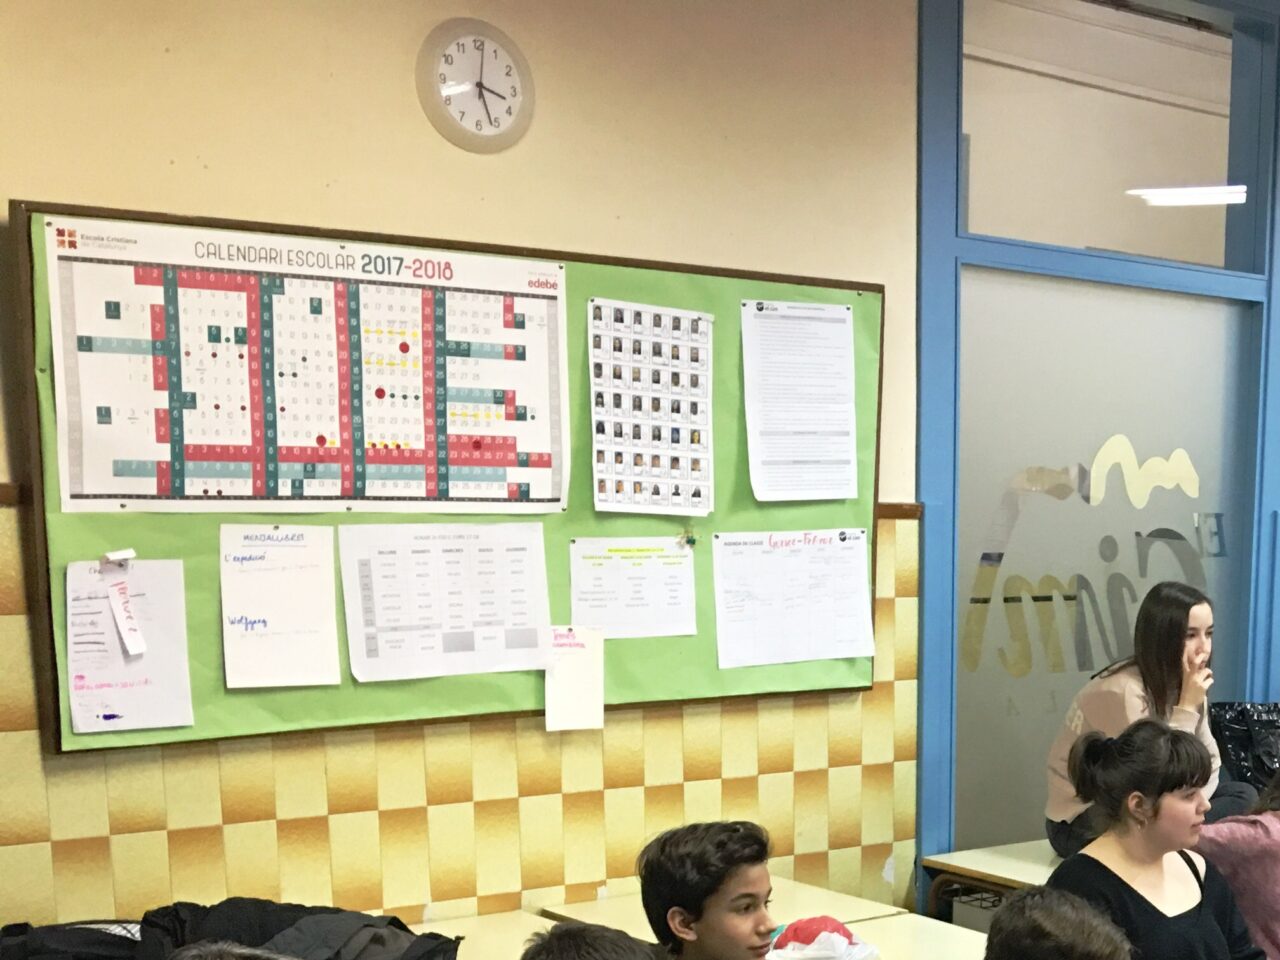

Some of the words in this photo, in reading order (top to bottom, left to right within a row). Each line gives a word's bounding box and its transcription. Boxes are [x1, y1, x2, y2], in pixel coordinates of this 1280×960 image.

[456, 42, 466, 54] 11
[472, 39, 484, 50] 12
[442, 54, 454, 66] 10
[493, 49, 498, 60] 1
[505, 65, 512, 76] 2
[439, 73, 446, 84] 9
[510, 86, 517, 97] 3
[444, 96, 452, 106] 8
[458, 111, 466, 122] 7
[506, 106, 512, 116] 4
[476, 120, 482, 132] 6
[494, 117, 500, 128] 5
[194, 241, 282, 265] CALENDARI
[287, 250, 356, 270] ESCOLAR
[361, 254, 454, 280] 2017-2018
[528, 278, 558, 290] edebé
